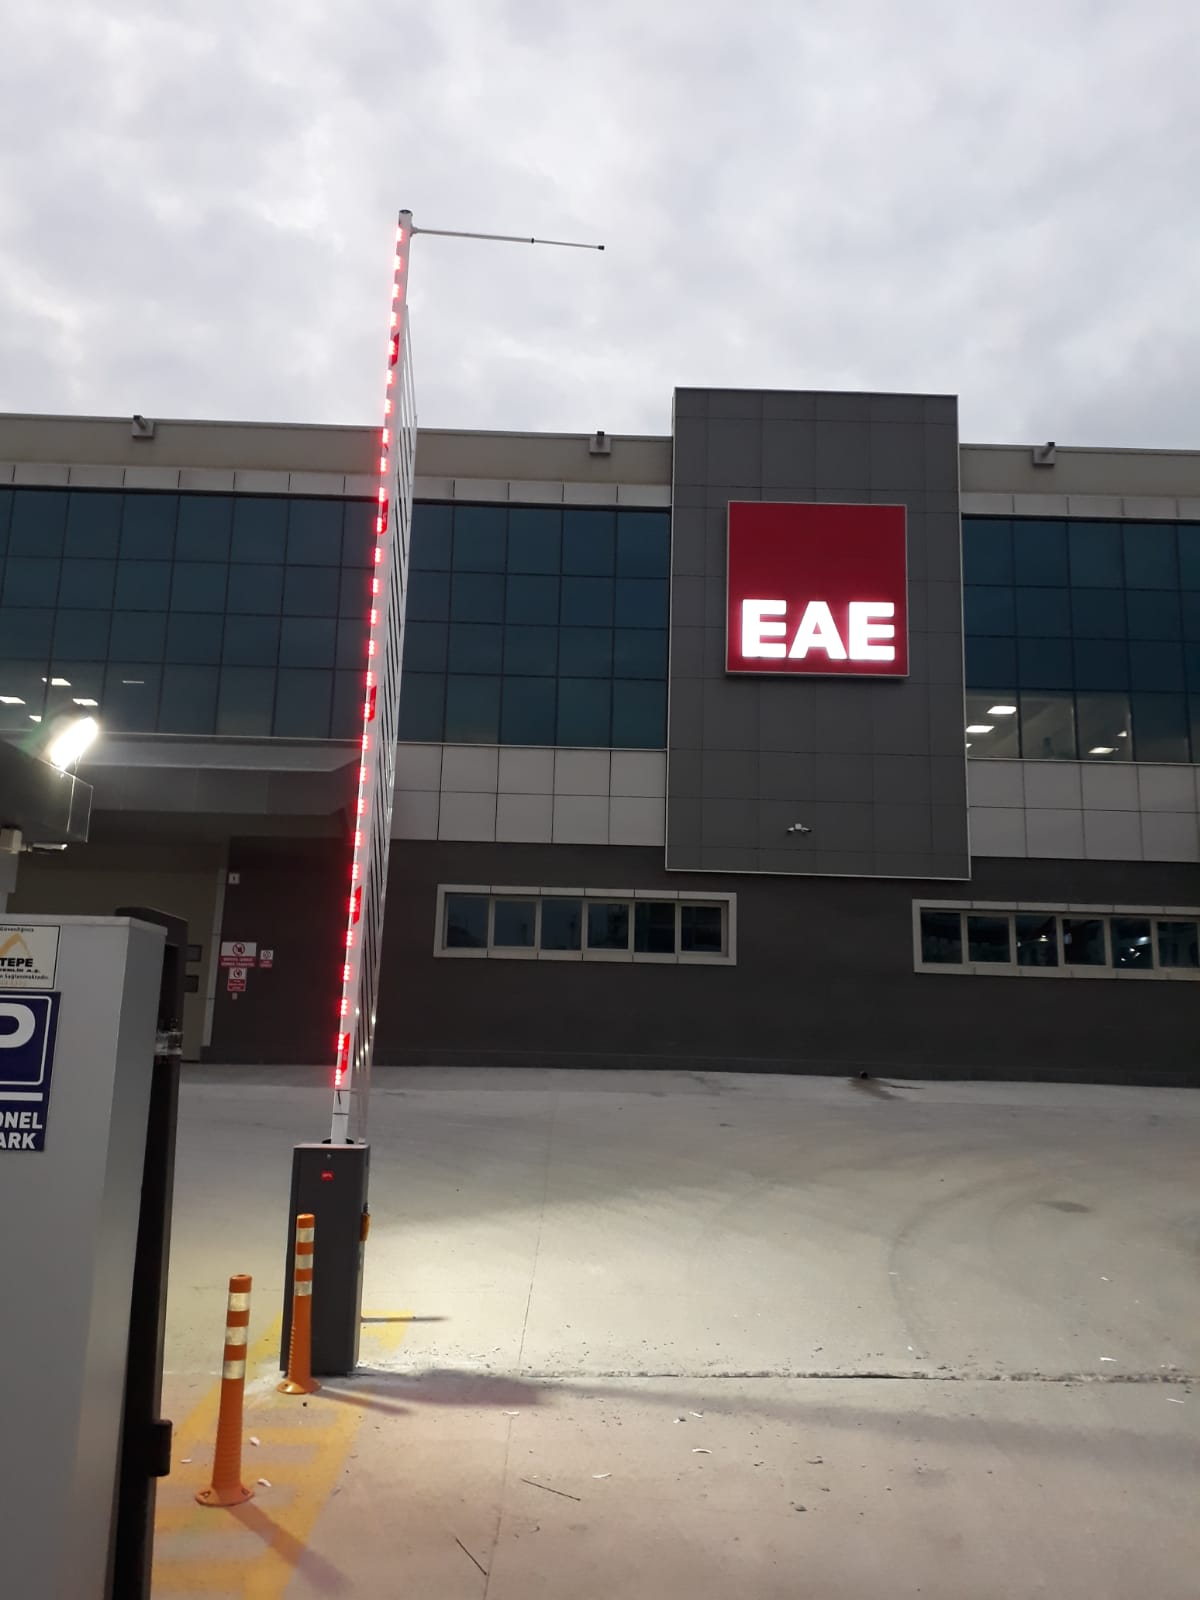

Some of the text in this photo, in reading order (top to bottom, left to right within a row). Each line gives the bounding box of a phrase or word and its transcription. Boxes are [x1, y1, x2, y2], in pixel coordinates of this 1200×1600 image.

[741, 599, 895, 660] EAE
[0, 957, 33, 967] TEPE
[0, 1112, 43, 1129] NEL
